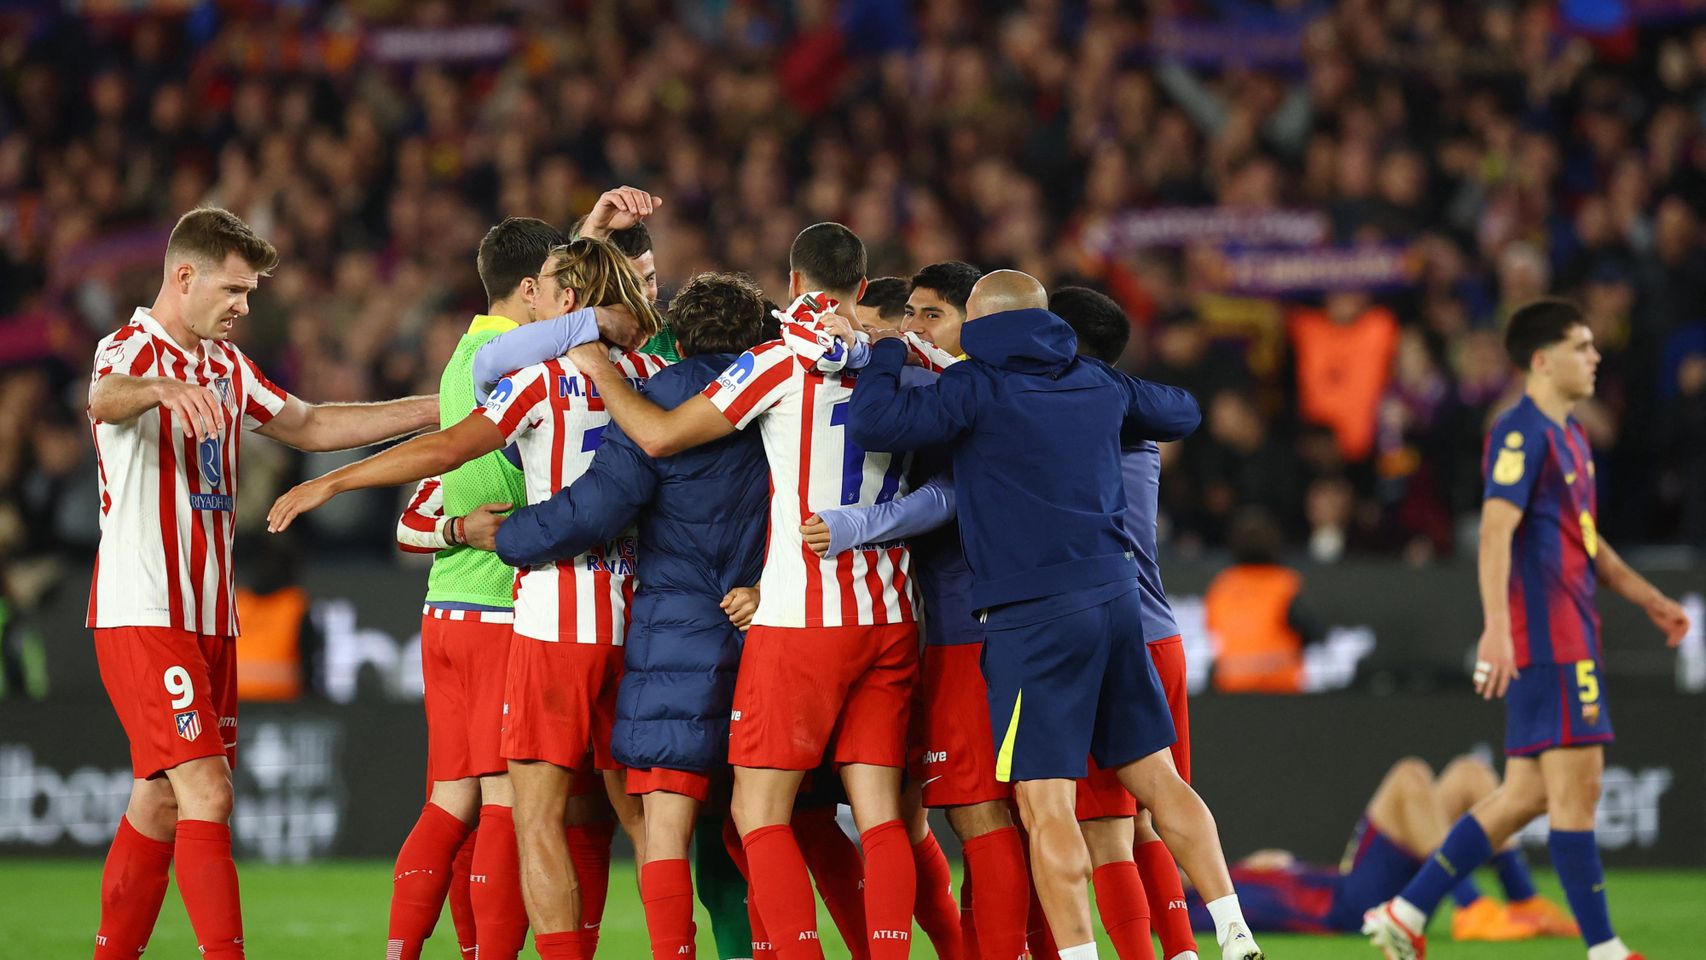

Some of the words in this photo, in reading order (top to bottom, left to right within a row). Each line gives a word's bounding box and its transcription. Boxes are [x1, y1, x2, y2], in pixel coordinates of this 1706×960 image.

[191, 495, 224, 509] RIYADH
[163, 665, 195, 710] 9
[1575, 659, 1599, 704] 5
[873, 930, 908, 941] ATLETI
